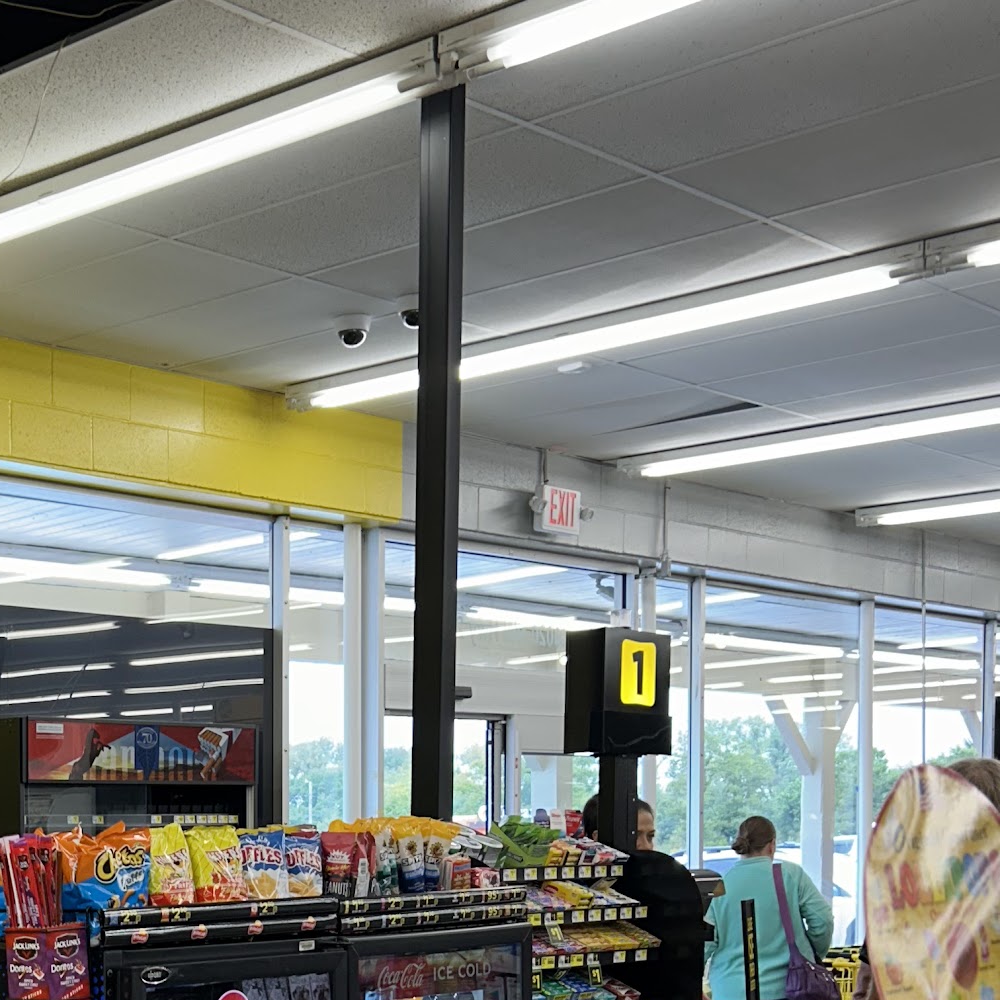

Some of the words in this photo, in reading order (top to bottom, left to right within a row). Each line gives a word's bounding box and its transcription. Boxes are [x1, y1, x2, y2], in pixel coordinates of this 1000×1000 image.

[549, 488, 577, 528] EXIT
[632, 650, 645, 695] 1
[94, 846, 146, 883] Cheetos
[433, 967, 455, 982] ICE
[458, 963, 492, 978] COLD
